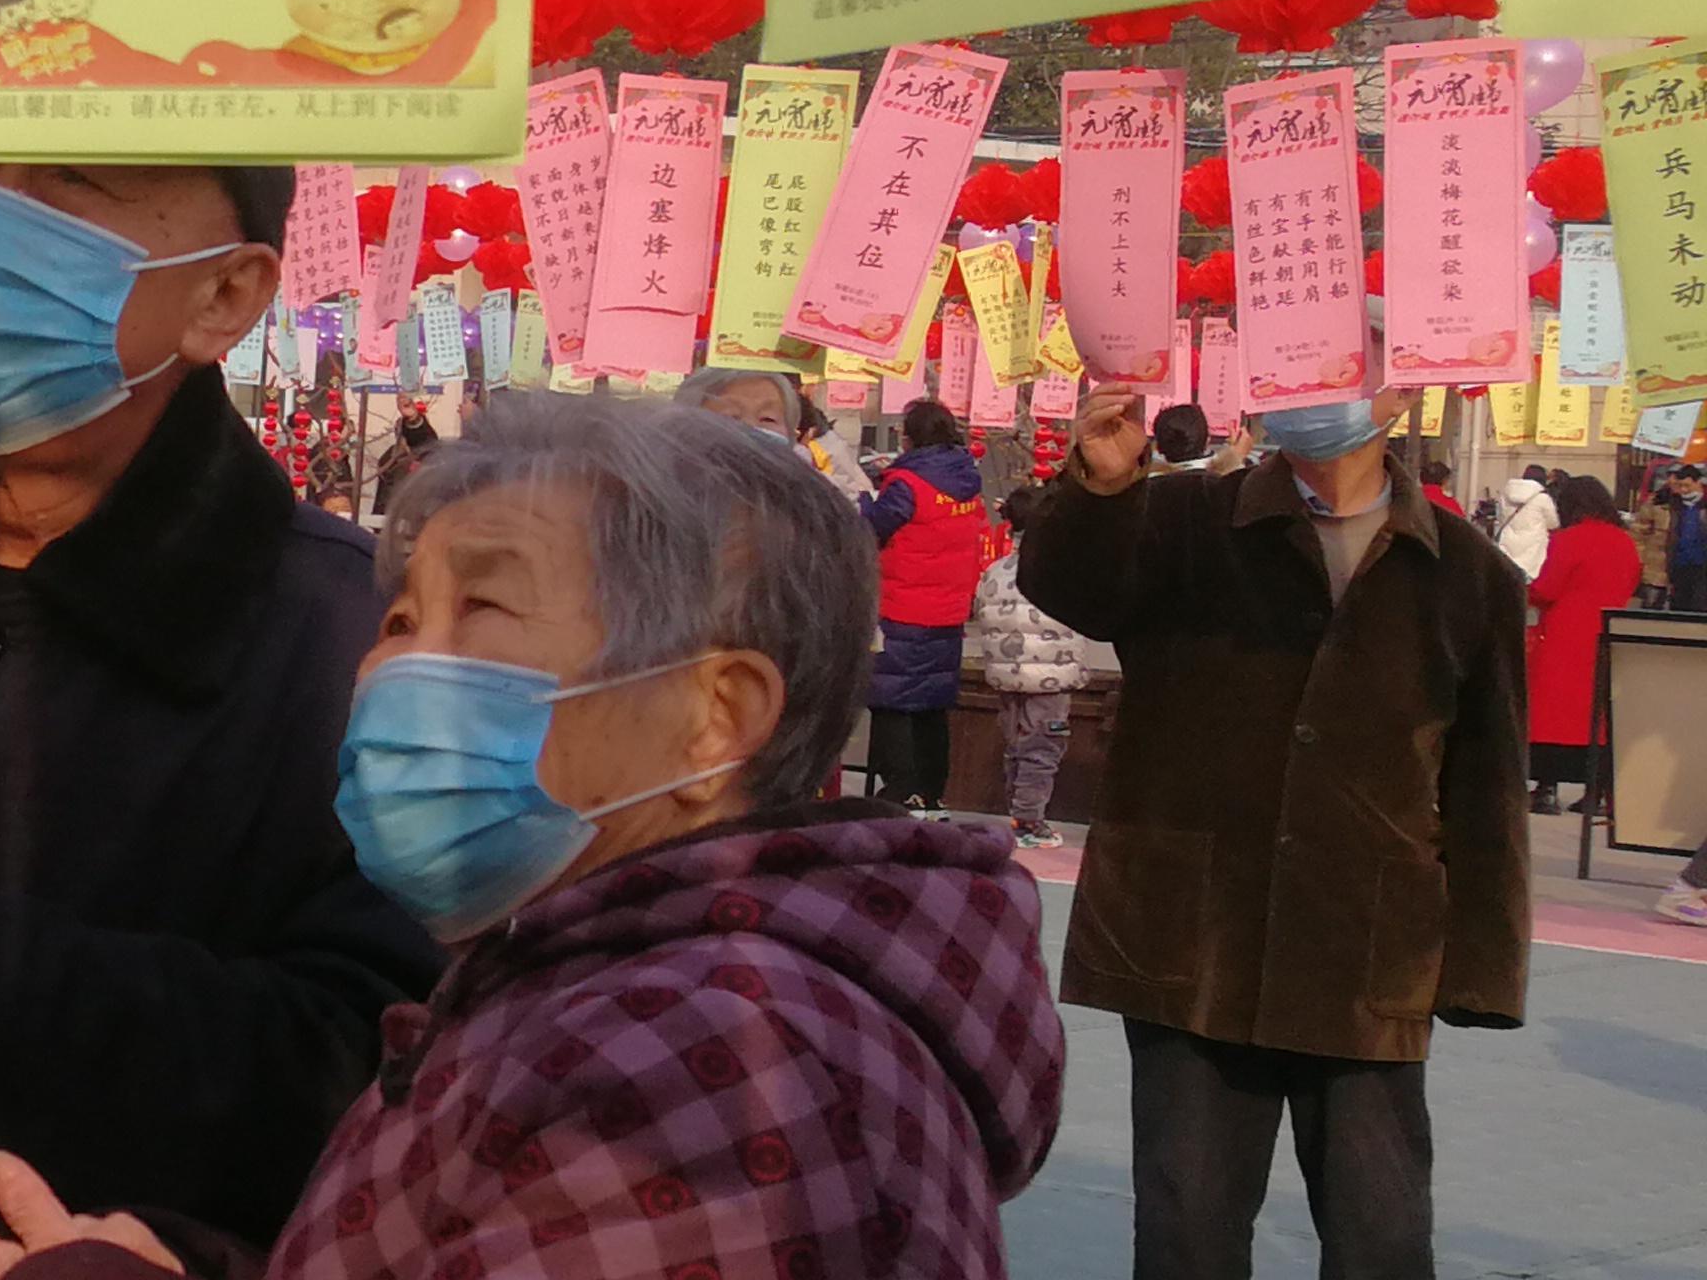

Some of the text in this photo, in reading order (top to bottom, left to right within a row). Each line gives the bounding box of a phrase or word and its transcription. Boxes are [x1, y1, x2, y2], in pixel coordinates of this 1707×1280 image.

[641, 163, 678, 295] 边塞烽火
[855, 134, 930, 269] 不在其位
[1110, 186, 1131, 298] 刑不上大夫
[1655, 147, 1706, 309] 兵马未动
